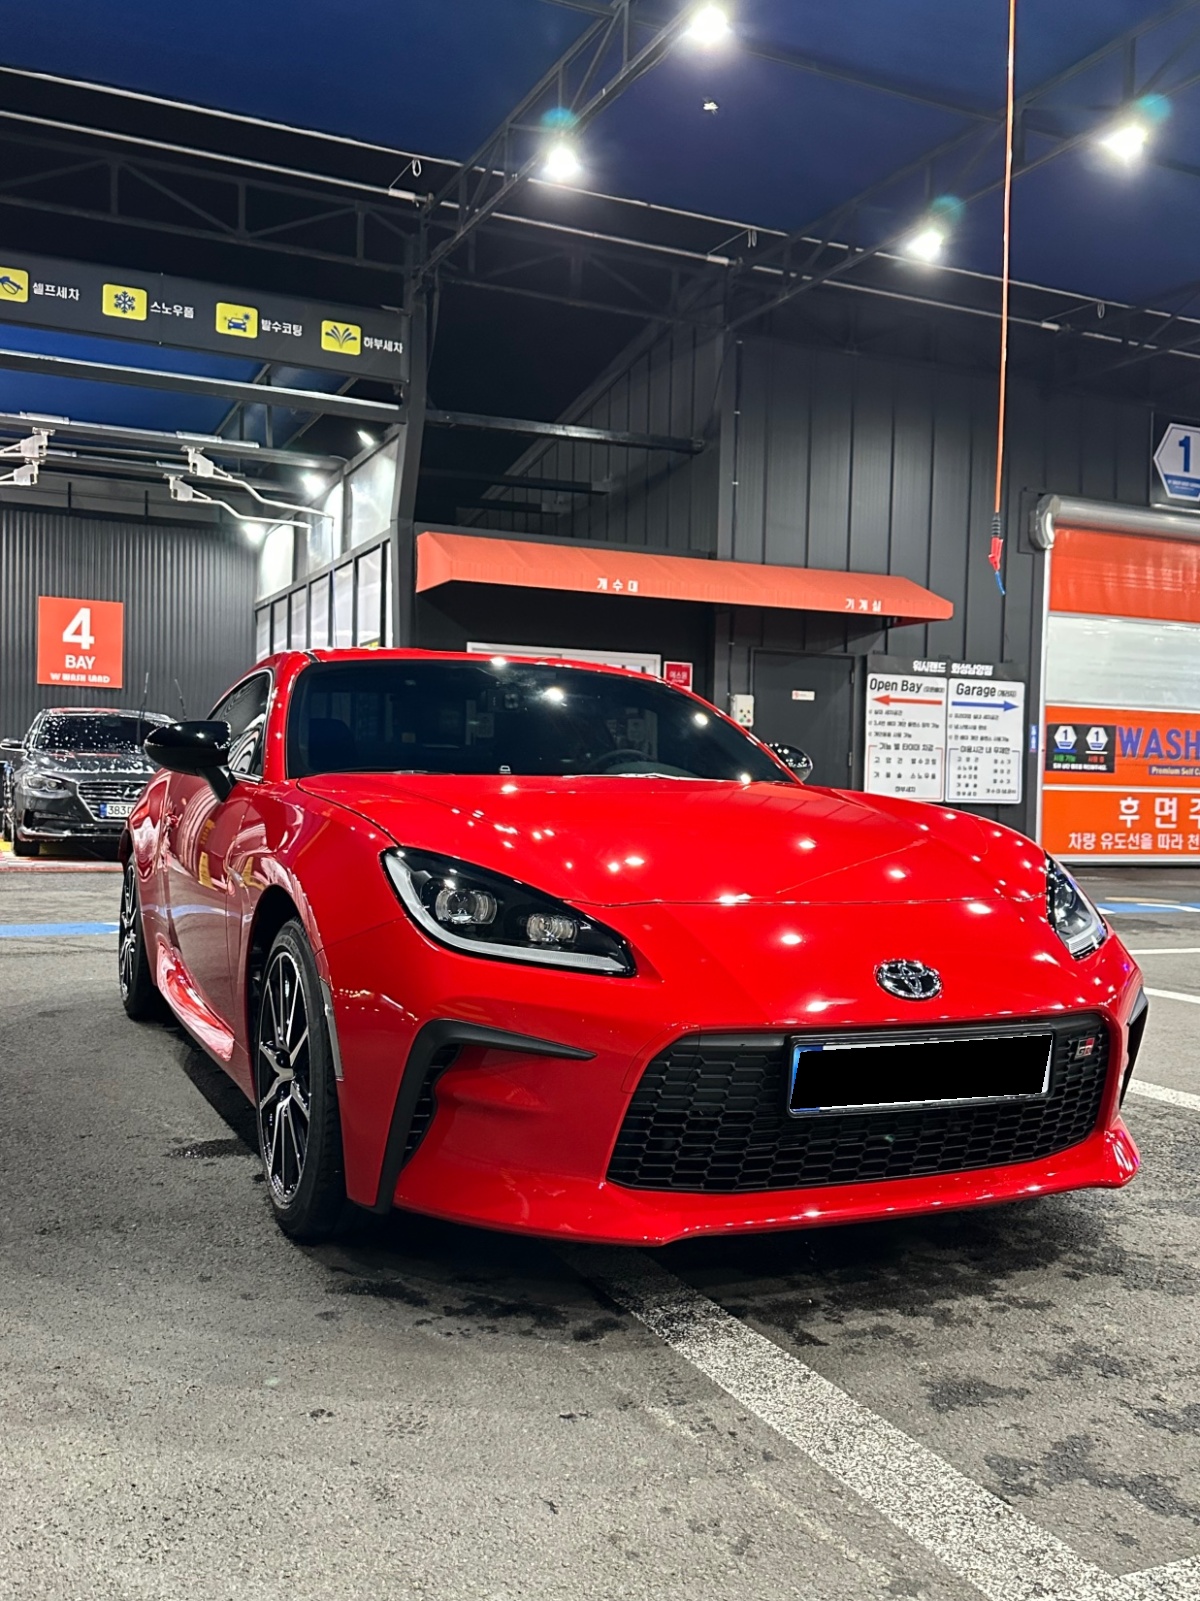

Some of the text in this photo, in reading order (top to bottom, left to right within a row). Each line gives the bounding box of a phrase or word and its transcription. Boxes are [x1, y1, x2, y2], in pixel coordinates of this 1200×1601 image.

[32, 281, 81, 301] 셀프세차
[260, 318, 303, 337] 발수코팅
[363, 336, 403, 354] 하부세차
[1178, 435, 1191, 473] 1
[62, 606, 95, 650] 4
[65, 654, 96, 670] BAY
[869, 678, 898, 692] Open
[900, 680, 923, 694] Bay
[956, 683, 996, 698] Garage
[1063, 729, 1068, 741] 1
[1094, 730, 1099, 742] 1
[1117, 726, 1200, 762] WASH
[1151, 766, 1180, 775] Premium
[1068, 832, 1097, 850] 차량
[1101, 833, 1153, 850] 유도선을
[1157, 833, 1184, 850] 따라
